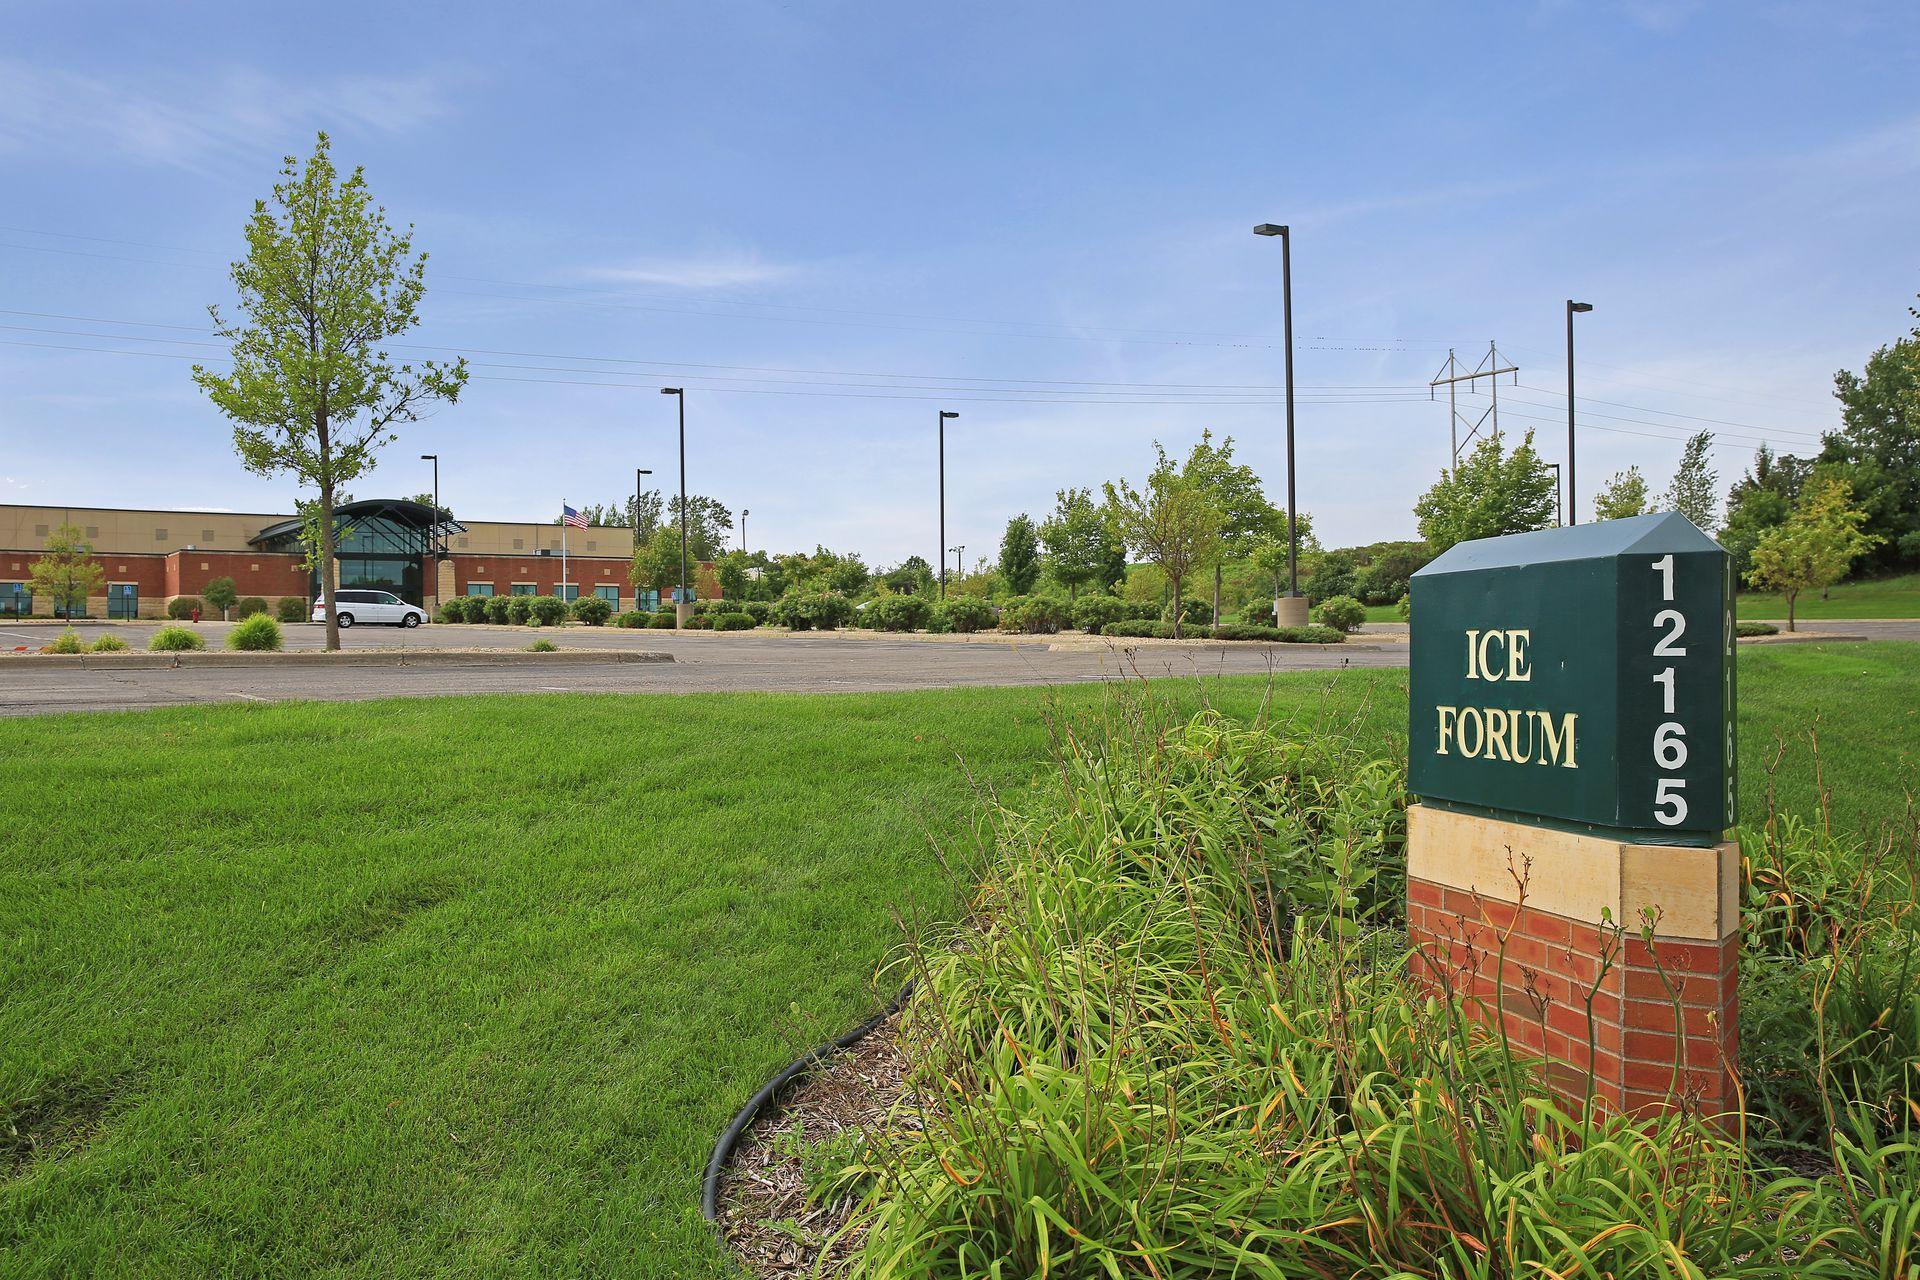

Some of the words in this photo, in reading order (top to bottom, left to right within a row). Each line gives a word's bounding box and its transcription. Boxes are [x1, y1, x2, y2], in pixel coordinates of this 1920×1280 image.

[1465, 629, 1532, 682] ICE
[1651, 554, 1687, 826] 12165
[1436, 705, 1579, 769] FORUM
